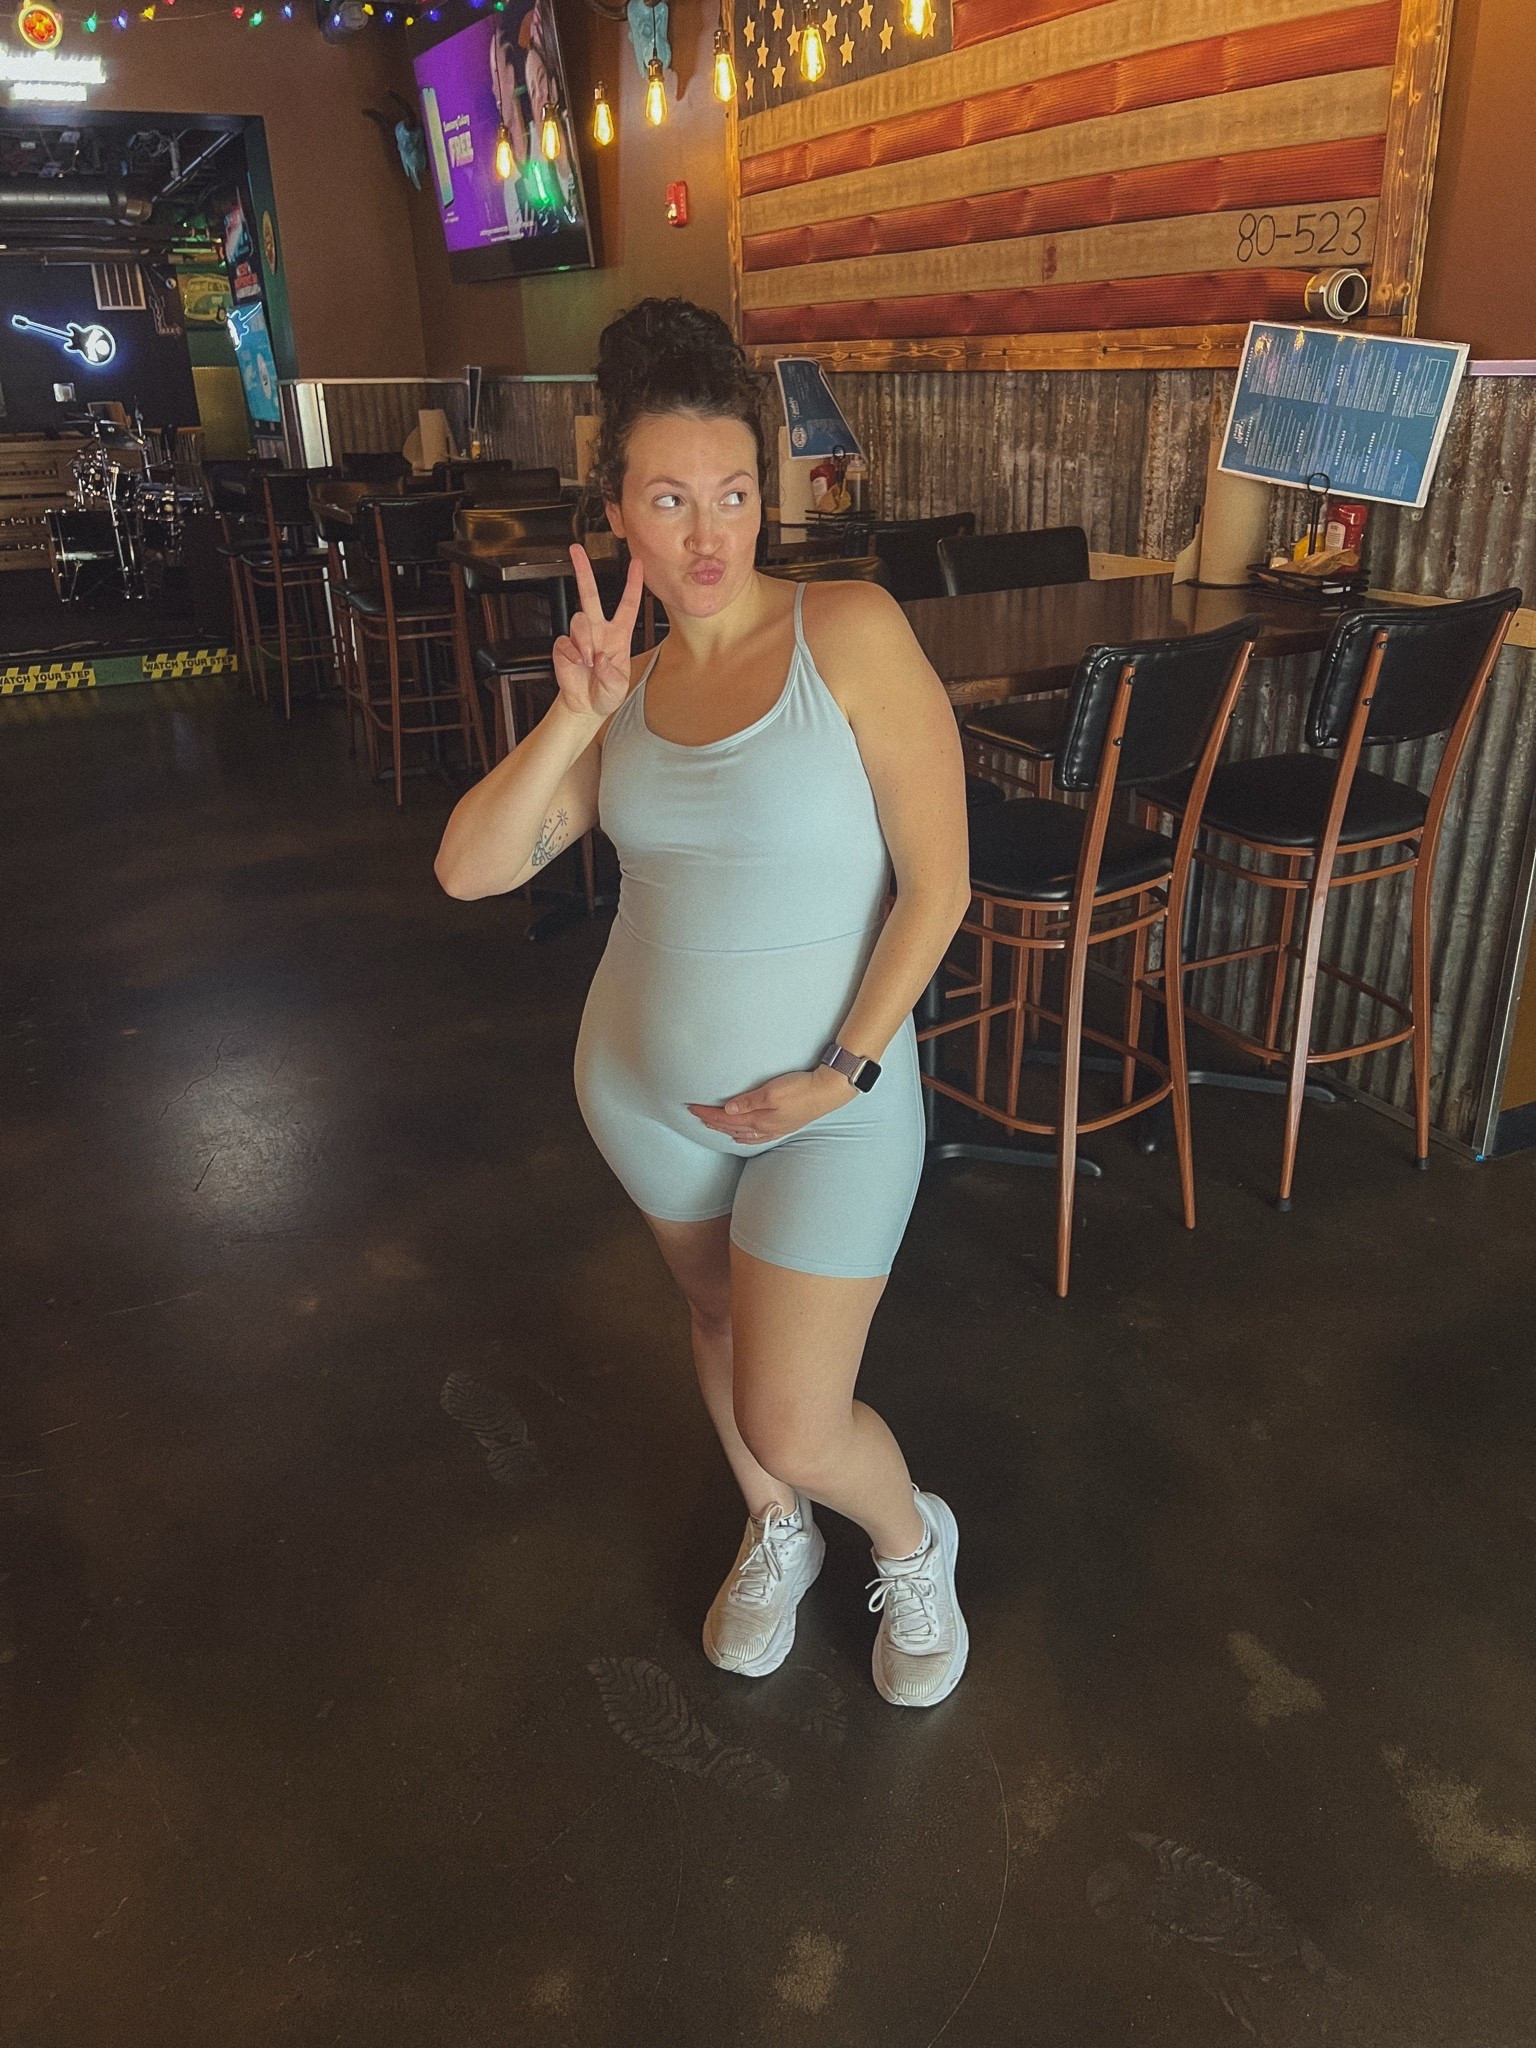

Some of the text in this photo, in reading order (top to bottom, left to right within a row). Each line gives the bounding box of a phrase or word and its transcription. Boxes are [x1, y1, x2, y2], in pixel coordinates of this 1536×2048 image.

[1236, 206, 1367, 263] 80-523
[144, 656, 234, 671] WATCH YOUR STEP
[34, 673, 62, 682] YOUR
[65, 670, 90, 680] STEP
